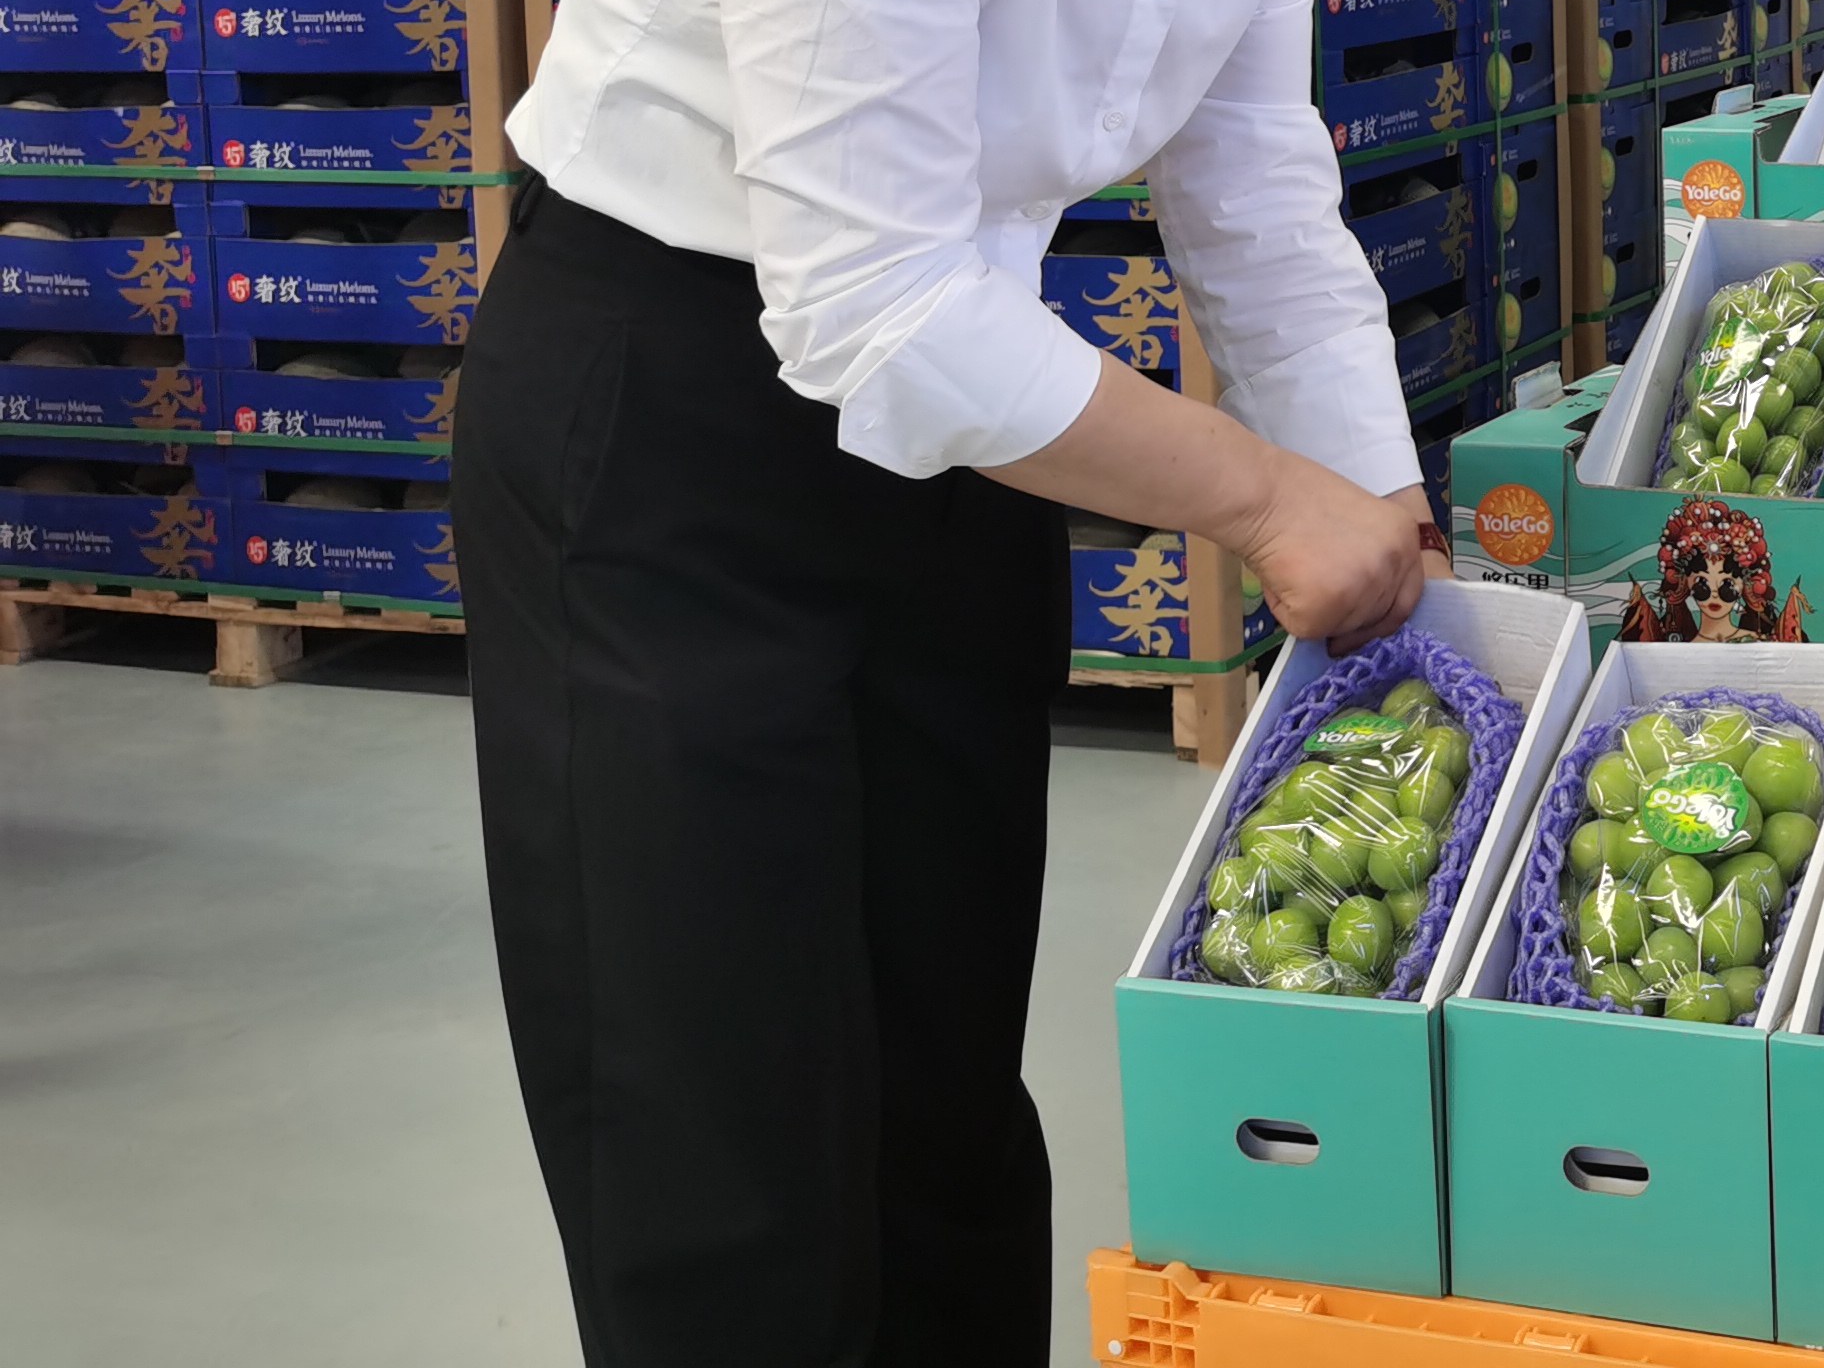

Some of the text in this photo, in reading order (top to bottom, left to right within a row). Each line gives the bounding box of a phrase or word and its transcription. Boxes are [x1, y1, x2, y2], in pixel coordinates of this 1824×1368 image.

[241, 9, 287, 37] 奢纹
[292, 13, 323, 26] Luxury
[248, 141, 295, 170] 奢纹
[300, 145, 331, 160] Luxury
[254, 275, 301, 304] 奢纹
[306, 279, 337, 293] Luxury
[261, 408, 308, 438] 奢纹
[313, 415, 345, 429] Luxury
[272, 538, 317, 568] 奢纹
[323, 545, 354, 559] Luxury
